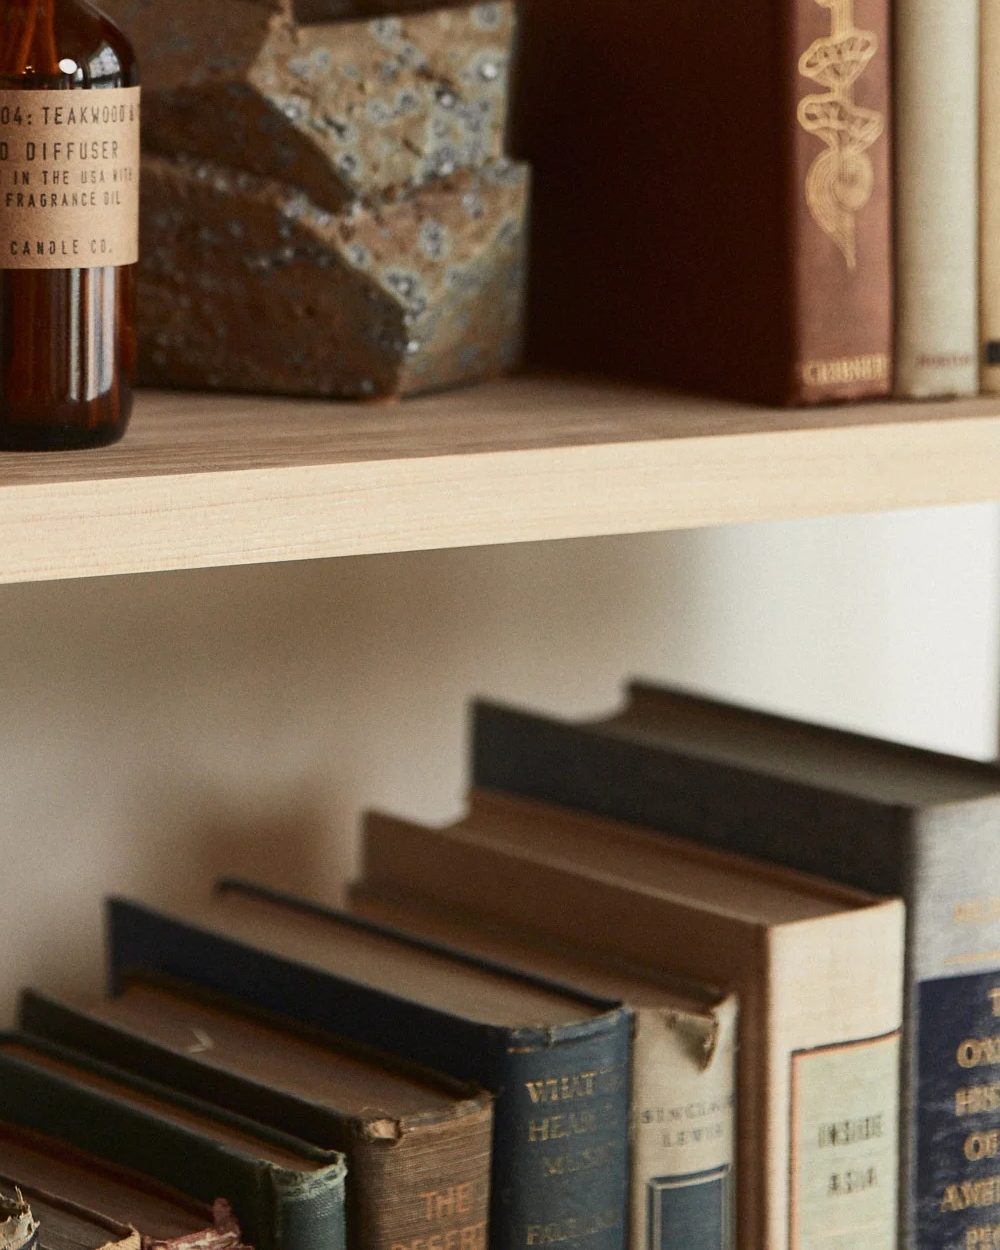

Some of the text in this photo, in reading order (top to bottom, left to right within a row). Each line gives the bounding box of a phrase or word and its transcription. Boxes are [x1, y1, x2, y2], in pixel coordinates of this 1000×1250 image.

[1, 105, 33, 126] 04:
[41, 104, 125, 125] TEAKWOOD
[26, 140, 118, 161] DIFFUSER
[13, 170, 30, 185] IN
[42, 170, 69, 185] THE
[81, 170, 105, 184] USA
[6, 191, 97, 208] FRAGRANCE
[103, 190, 121, 206] OIL
[9, 239, 80, 256] CANDLE
[90, 238, 113, 254] CO.
[417, 1180, 475, 1221] THE
